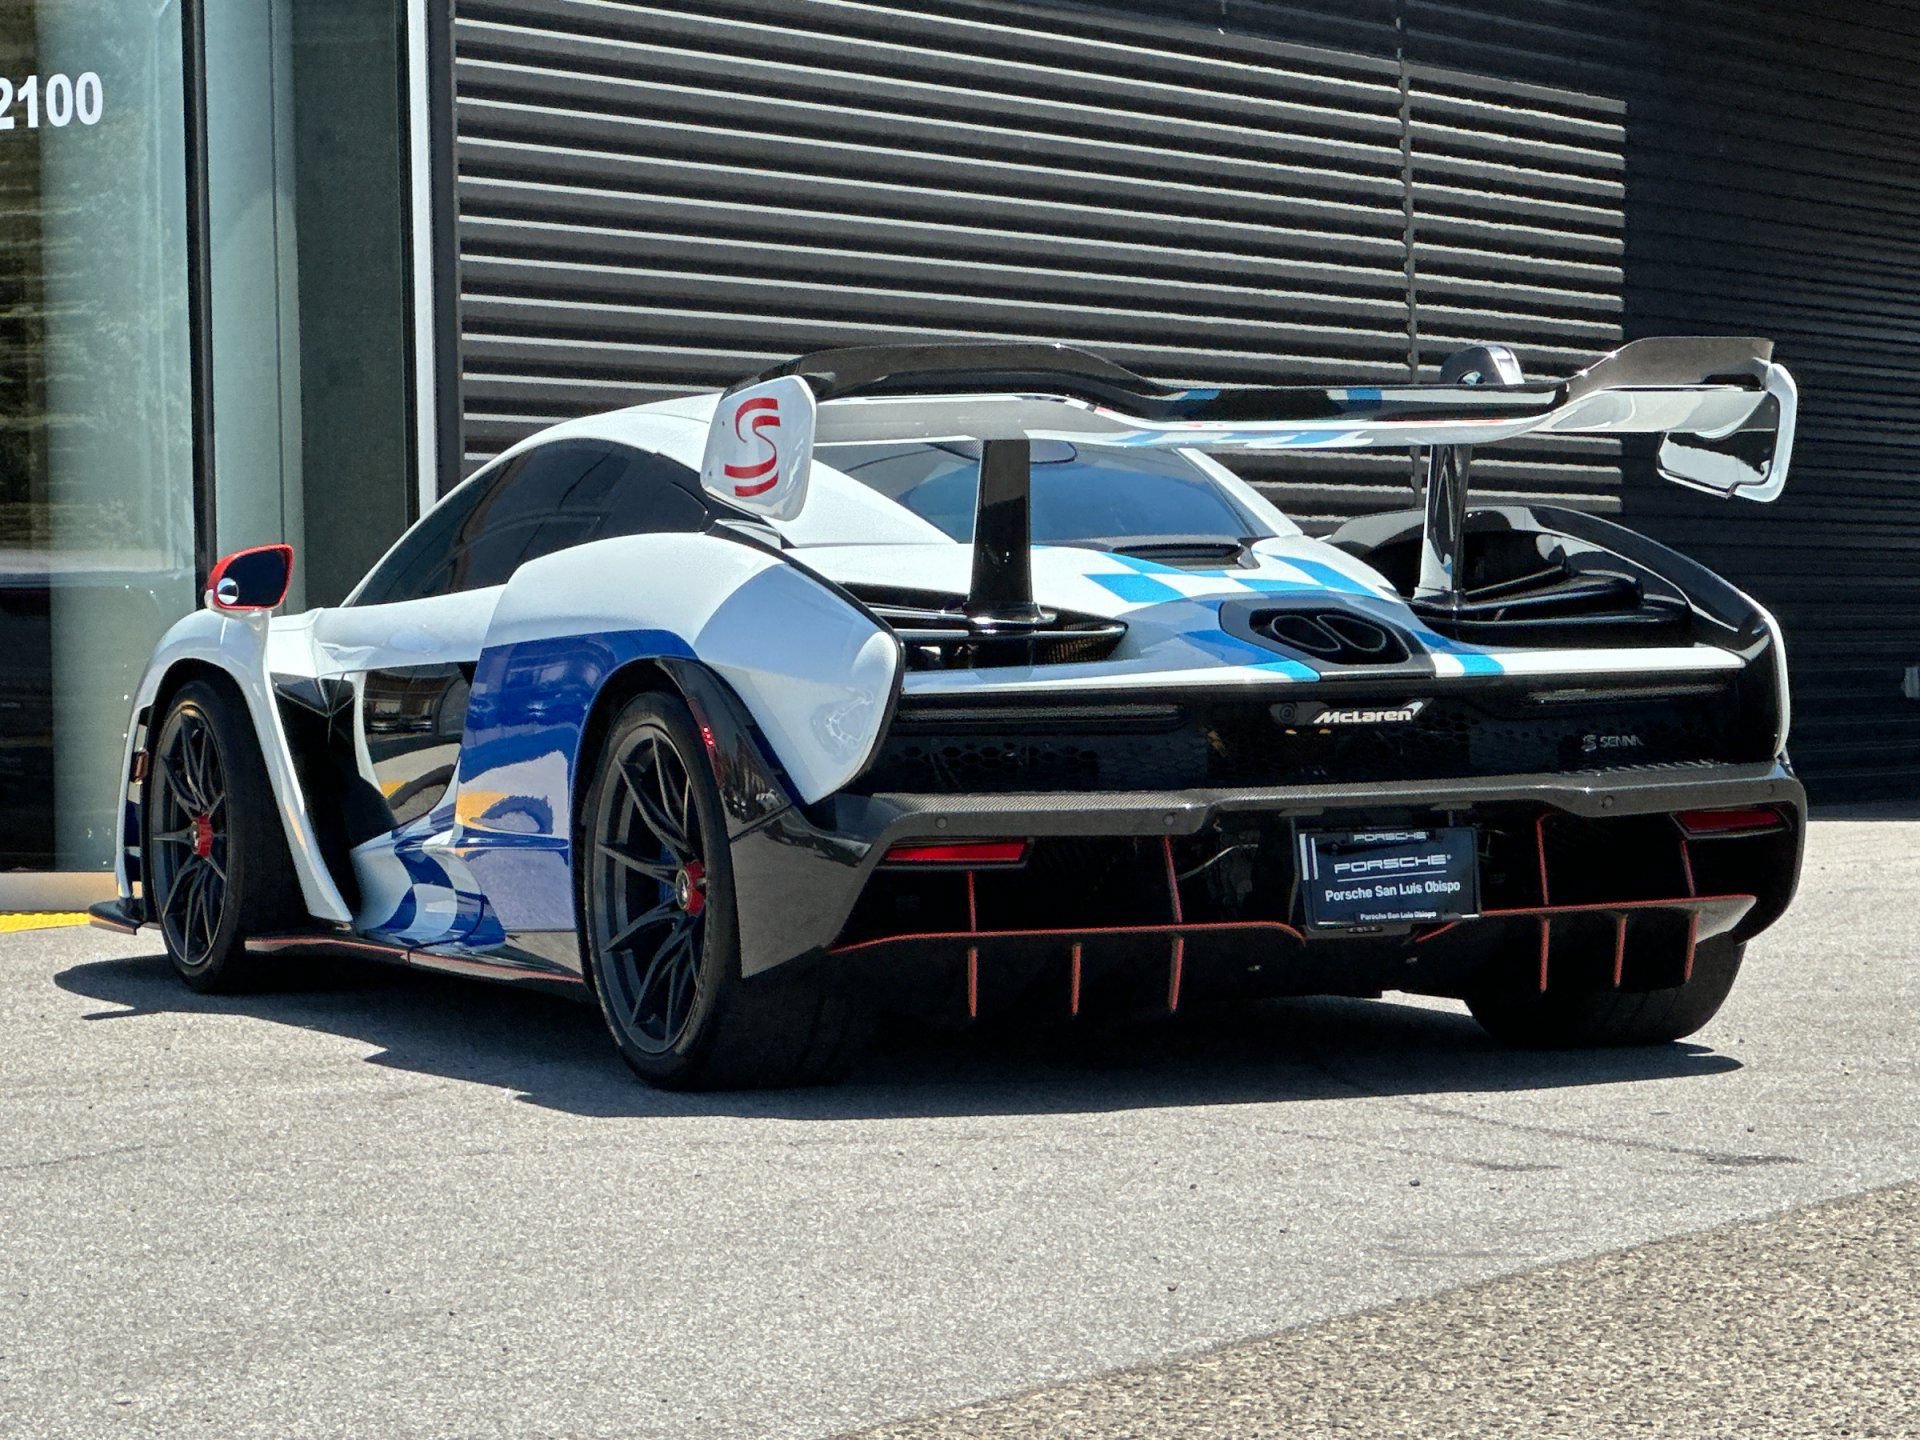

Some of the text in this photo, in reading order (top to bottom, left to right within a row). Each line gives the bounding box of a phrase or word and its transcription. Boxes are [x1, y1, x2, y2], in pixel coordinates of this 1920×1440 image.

[1313, 711, 1412, 723] McLaren
[1600, 735, 1645, 748] SENNA
[1353, 831, 1427, 842] PORSCHE
[1334, 854, 1447, 874] PORSCHE
[1325, 880, 1461, 902] Porsche San Luis Obispo
[1360, 910, 1437, 920] Porsche San Luis Obispo
